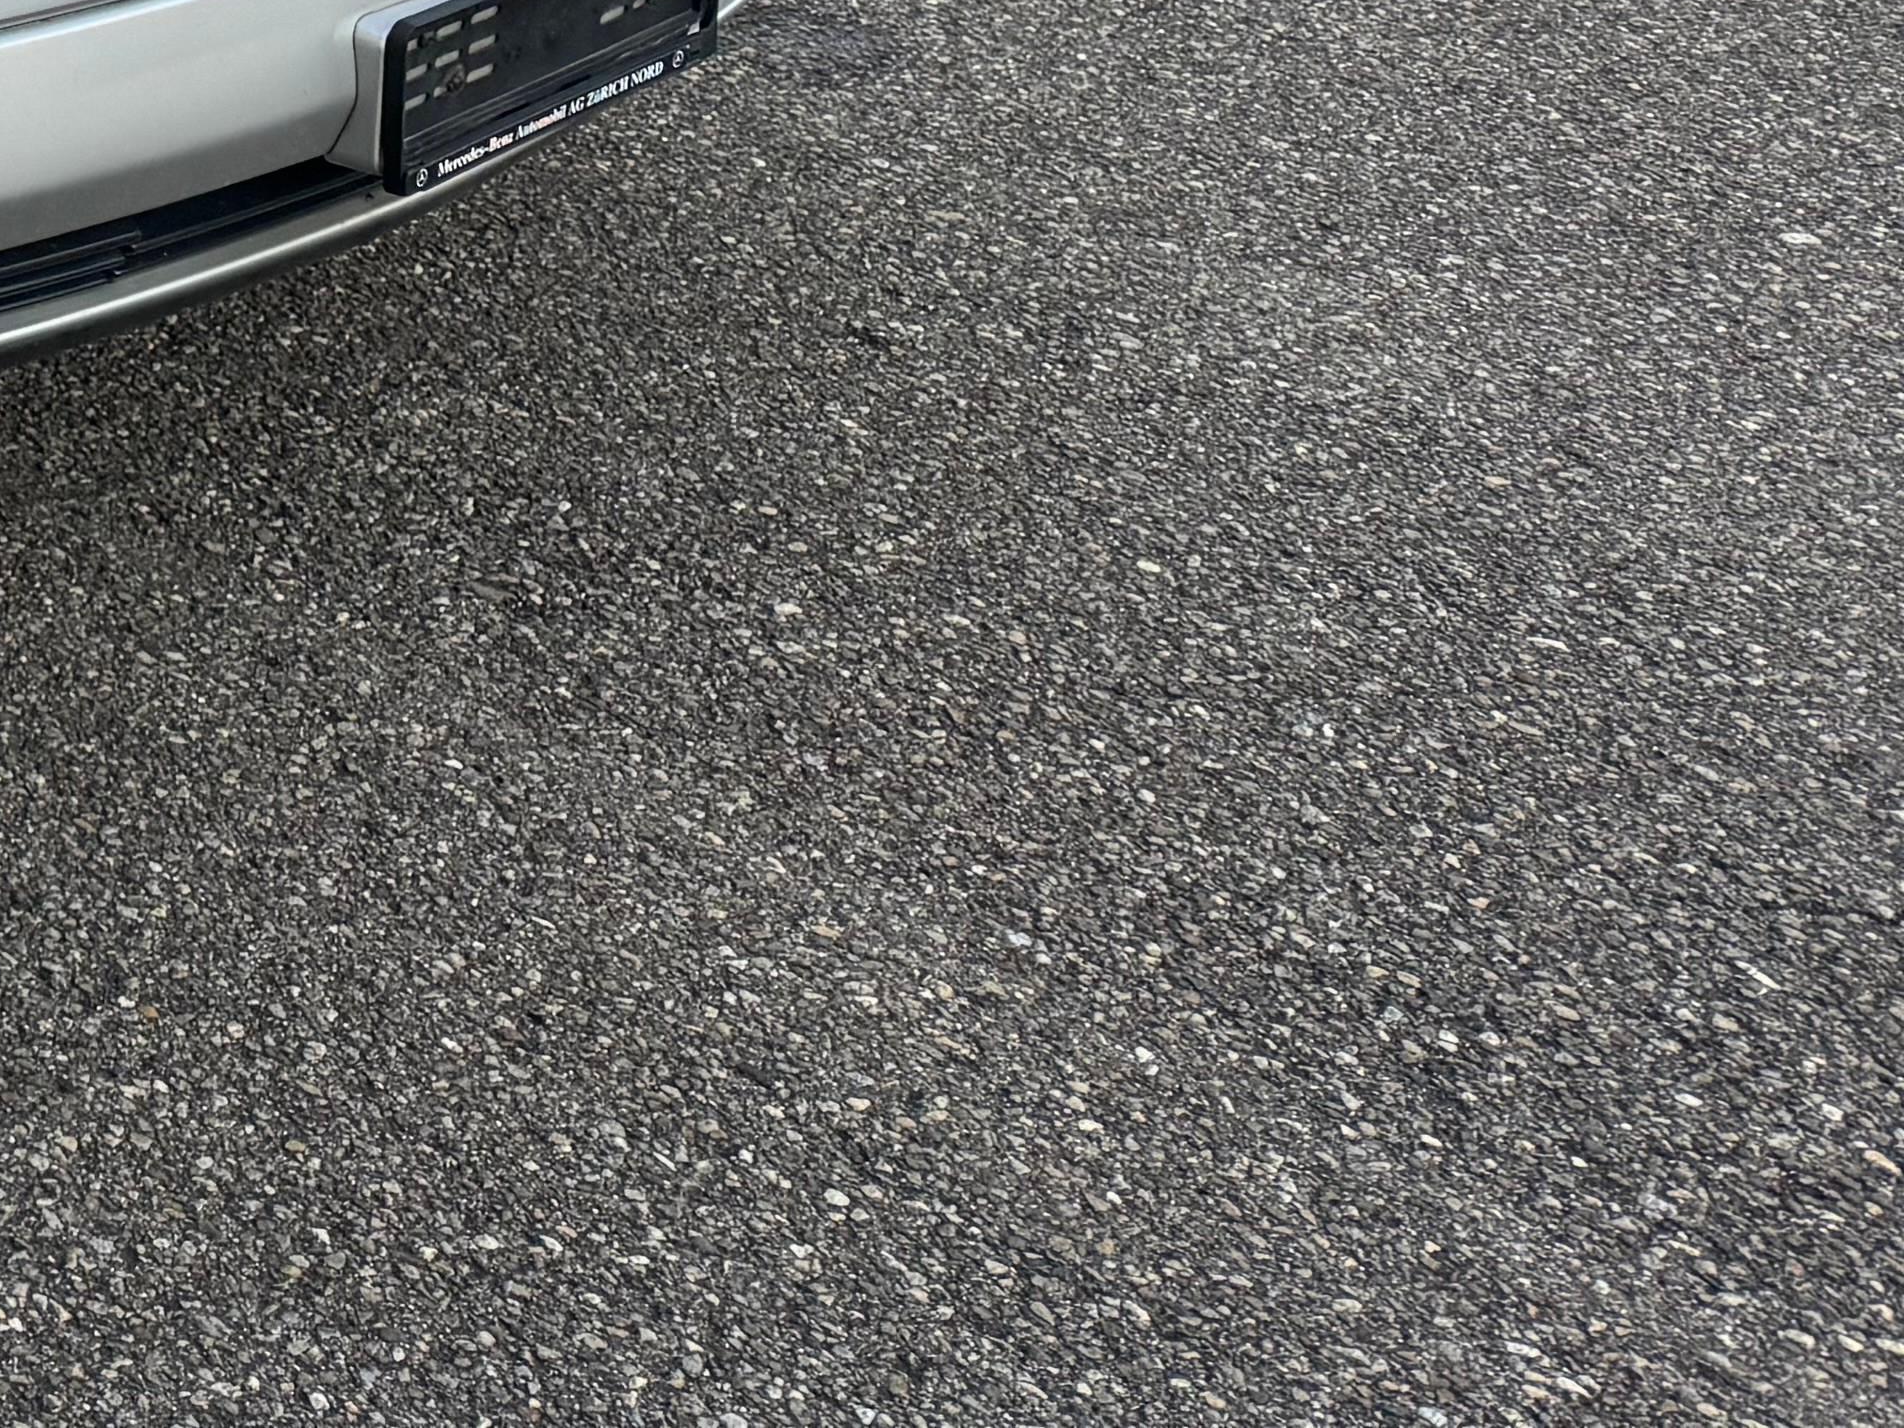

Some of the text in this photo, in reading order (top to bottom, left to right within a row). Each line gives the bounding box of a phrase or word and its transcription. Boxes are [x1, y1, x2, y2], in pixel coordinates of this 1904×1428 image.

[437, 130, 514, 177] Mercedes-Benz
[515, 104, 568, 139] Automobil
[567, 97, 587, 116] AG
[630, 60, 664, 87] NORD
